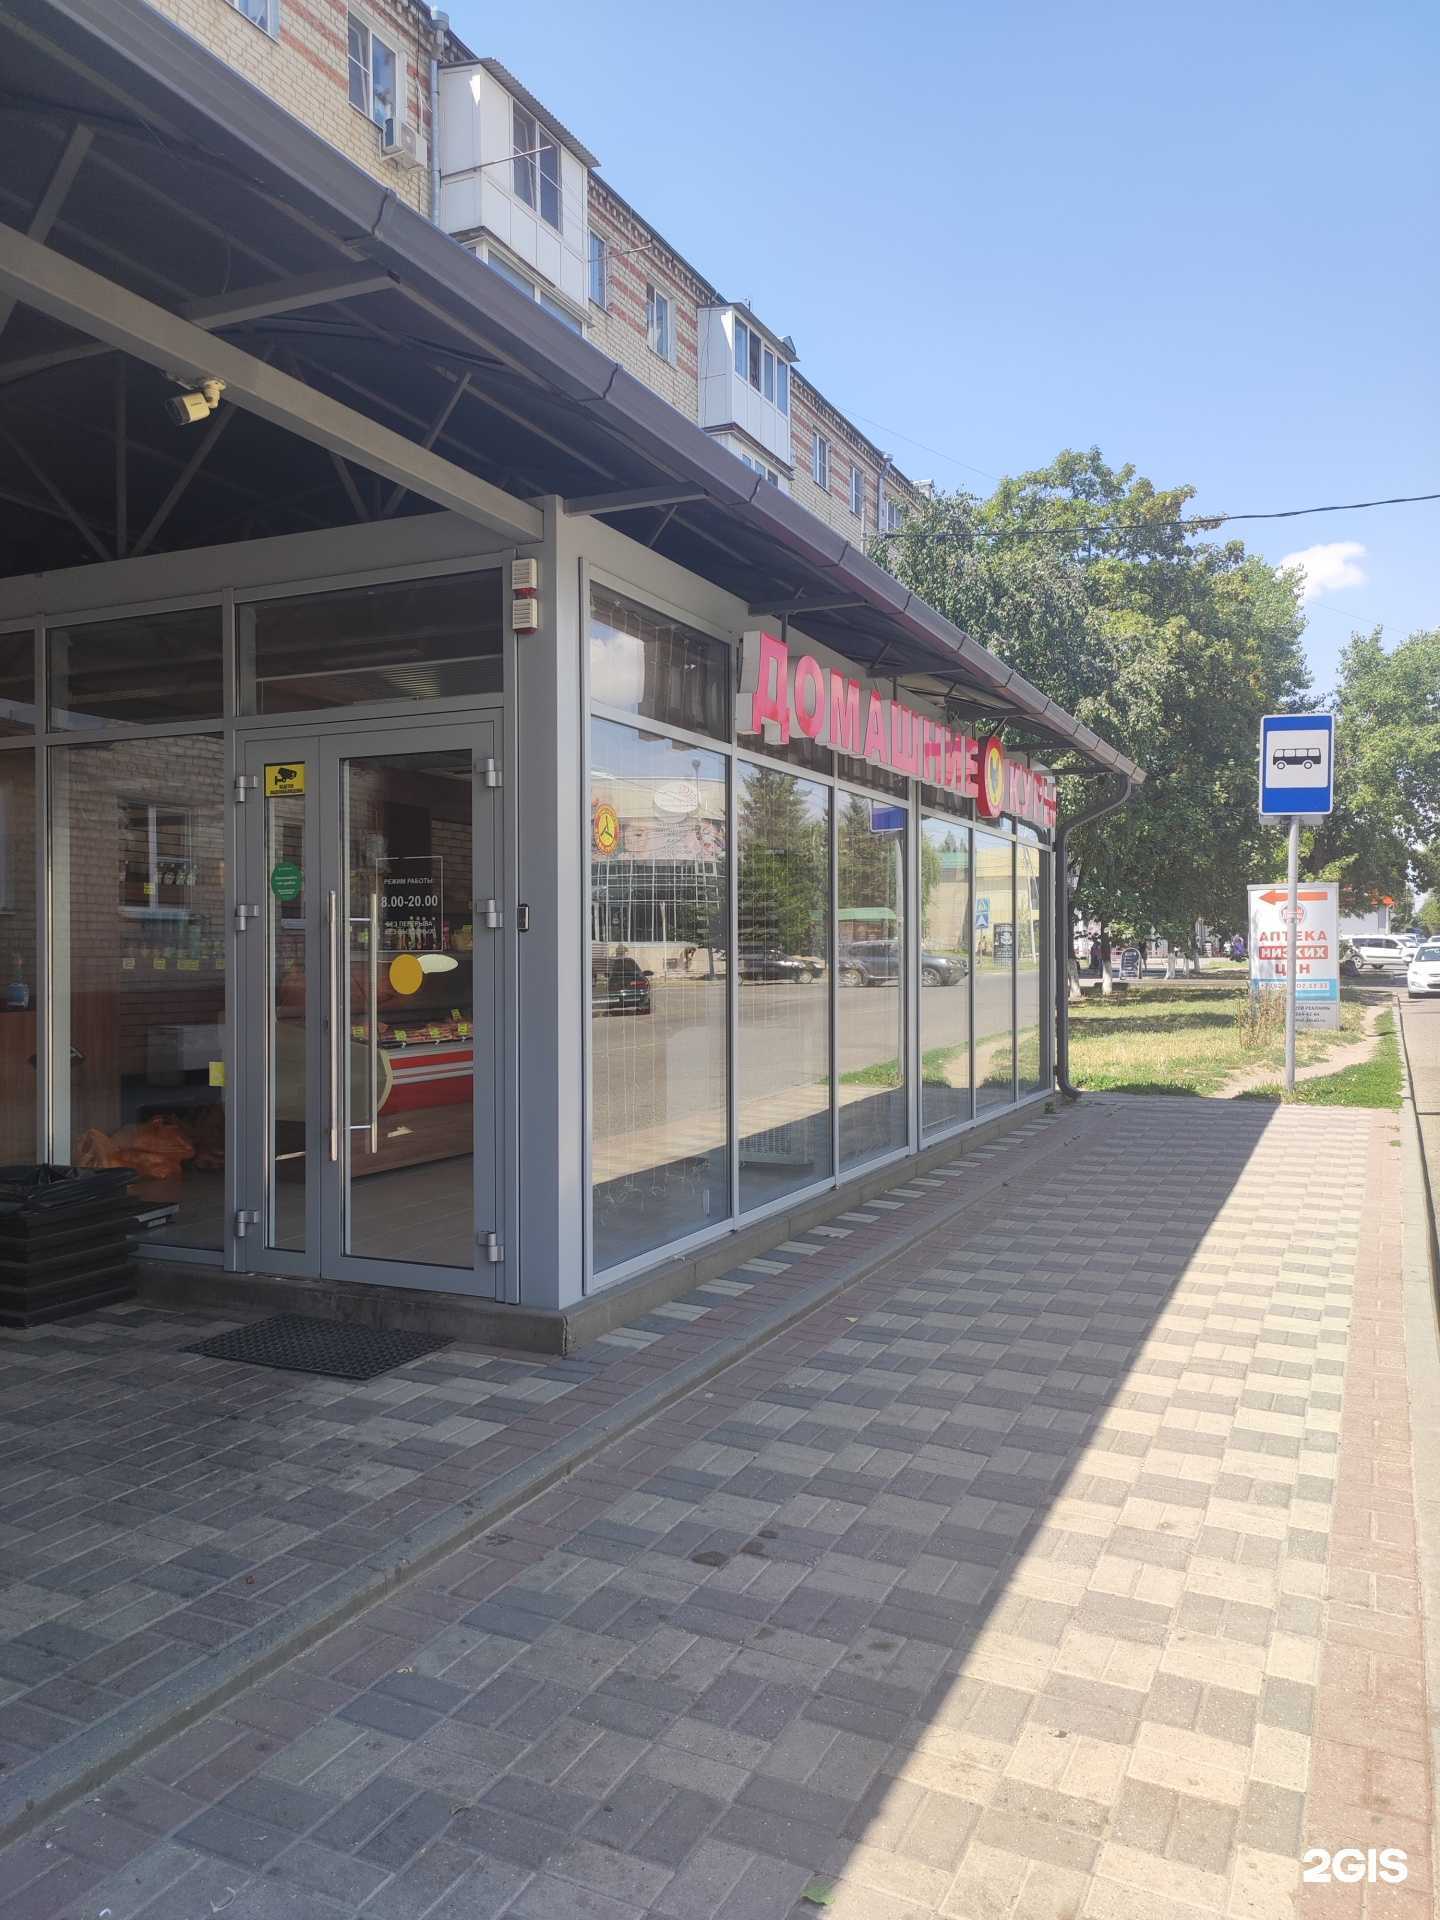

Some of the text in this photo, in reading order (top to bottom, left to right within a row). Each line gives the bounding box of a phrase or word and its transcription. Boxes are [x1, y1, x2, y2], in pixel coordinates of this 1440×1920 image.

[751, 631, 979, 799] ДОМАШНИЕ
[407, 877, 433, 885] РАБОТЫ
[381, 895, 438, 909] 8.00-20.00
[1275, 963, 1311, 976] ЦН
